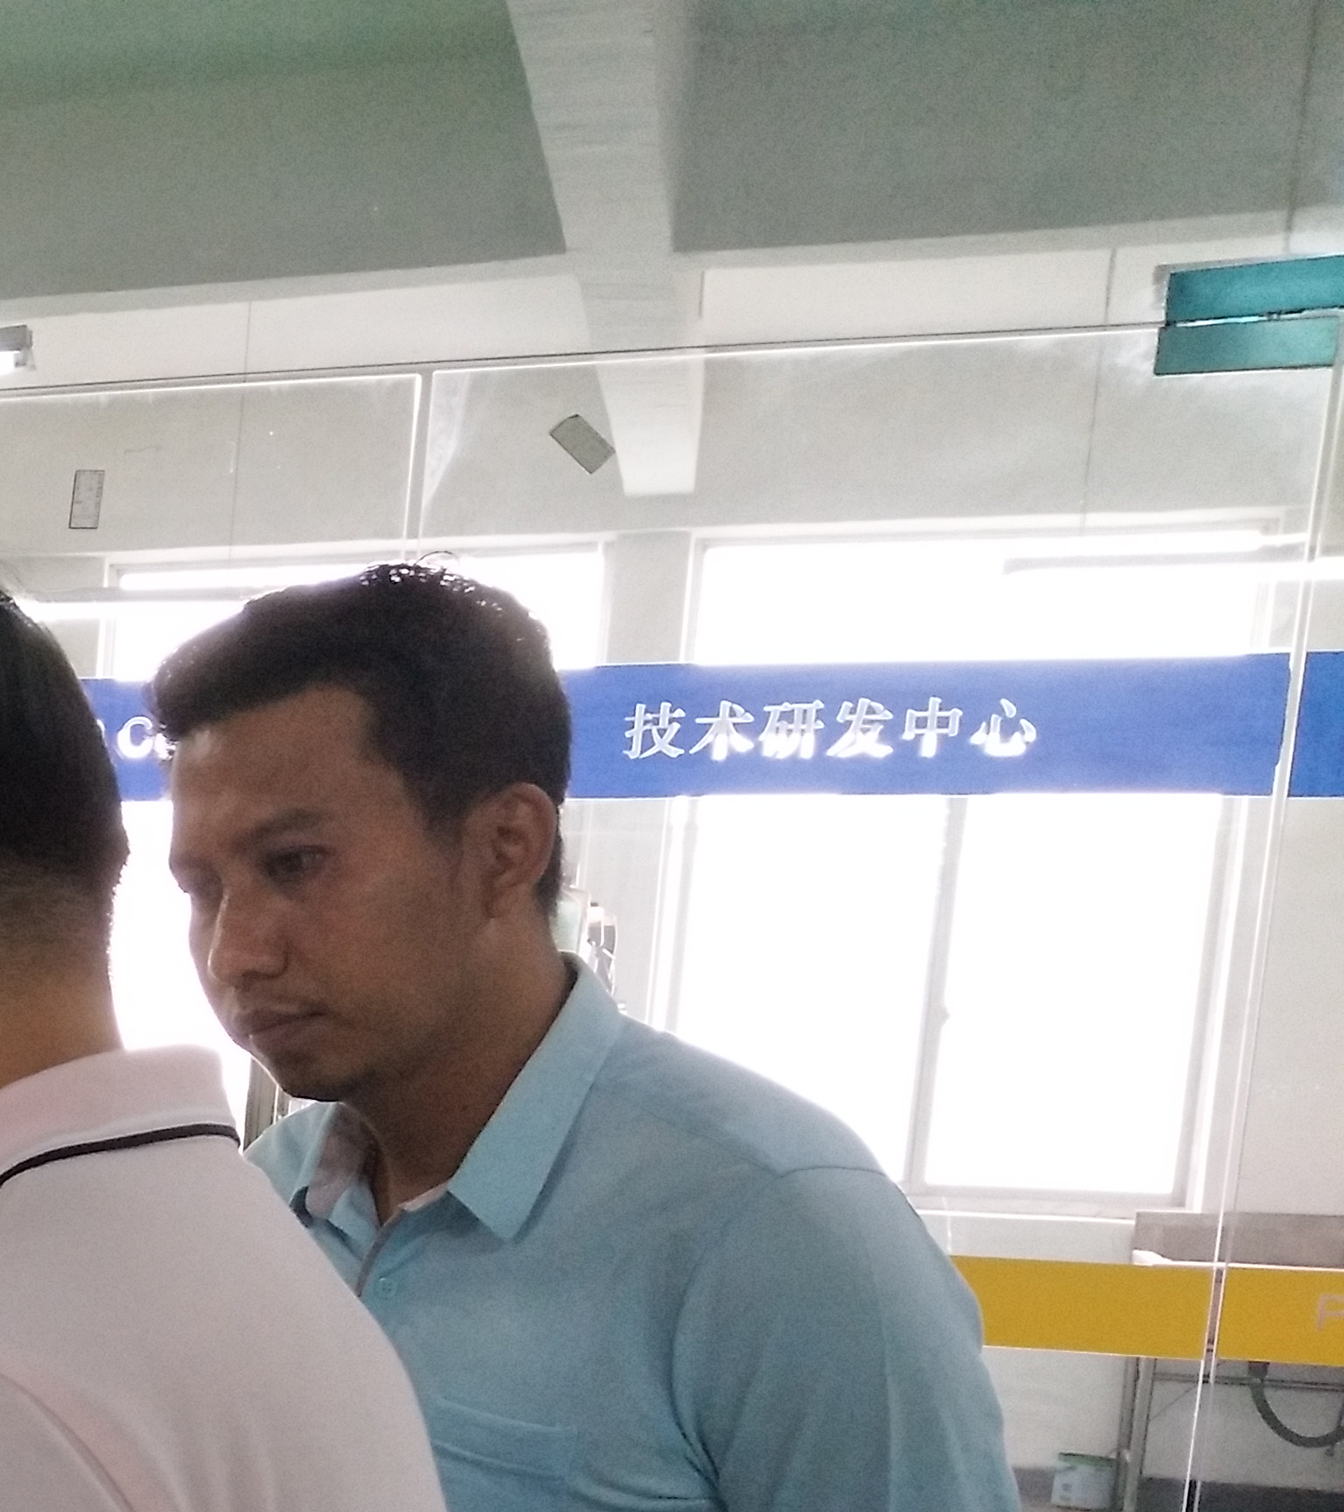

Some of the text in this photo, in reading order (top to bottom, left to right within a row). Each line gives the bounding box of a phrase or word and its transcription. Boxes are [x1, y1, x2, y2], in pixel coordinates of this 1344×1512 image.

[622, 697, 1037, 761] 技术研发中心
